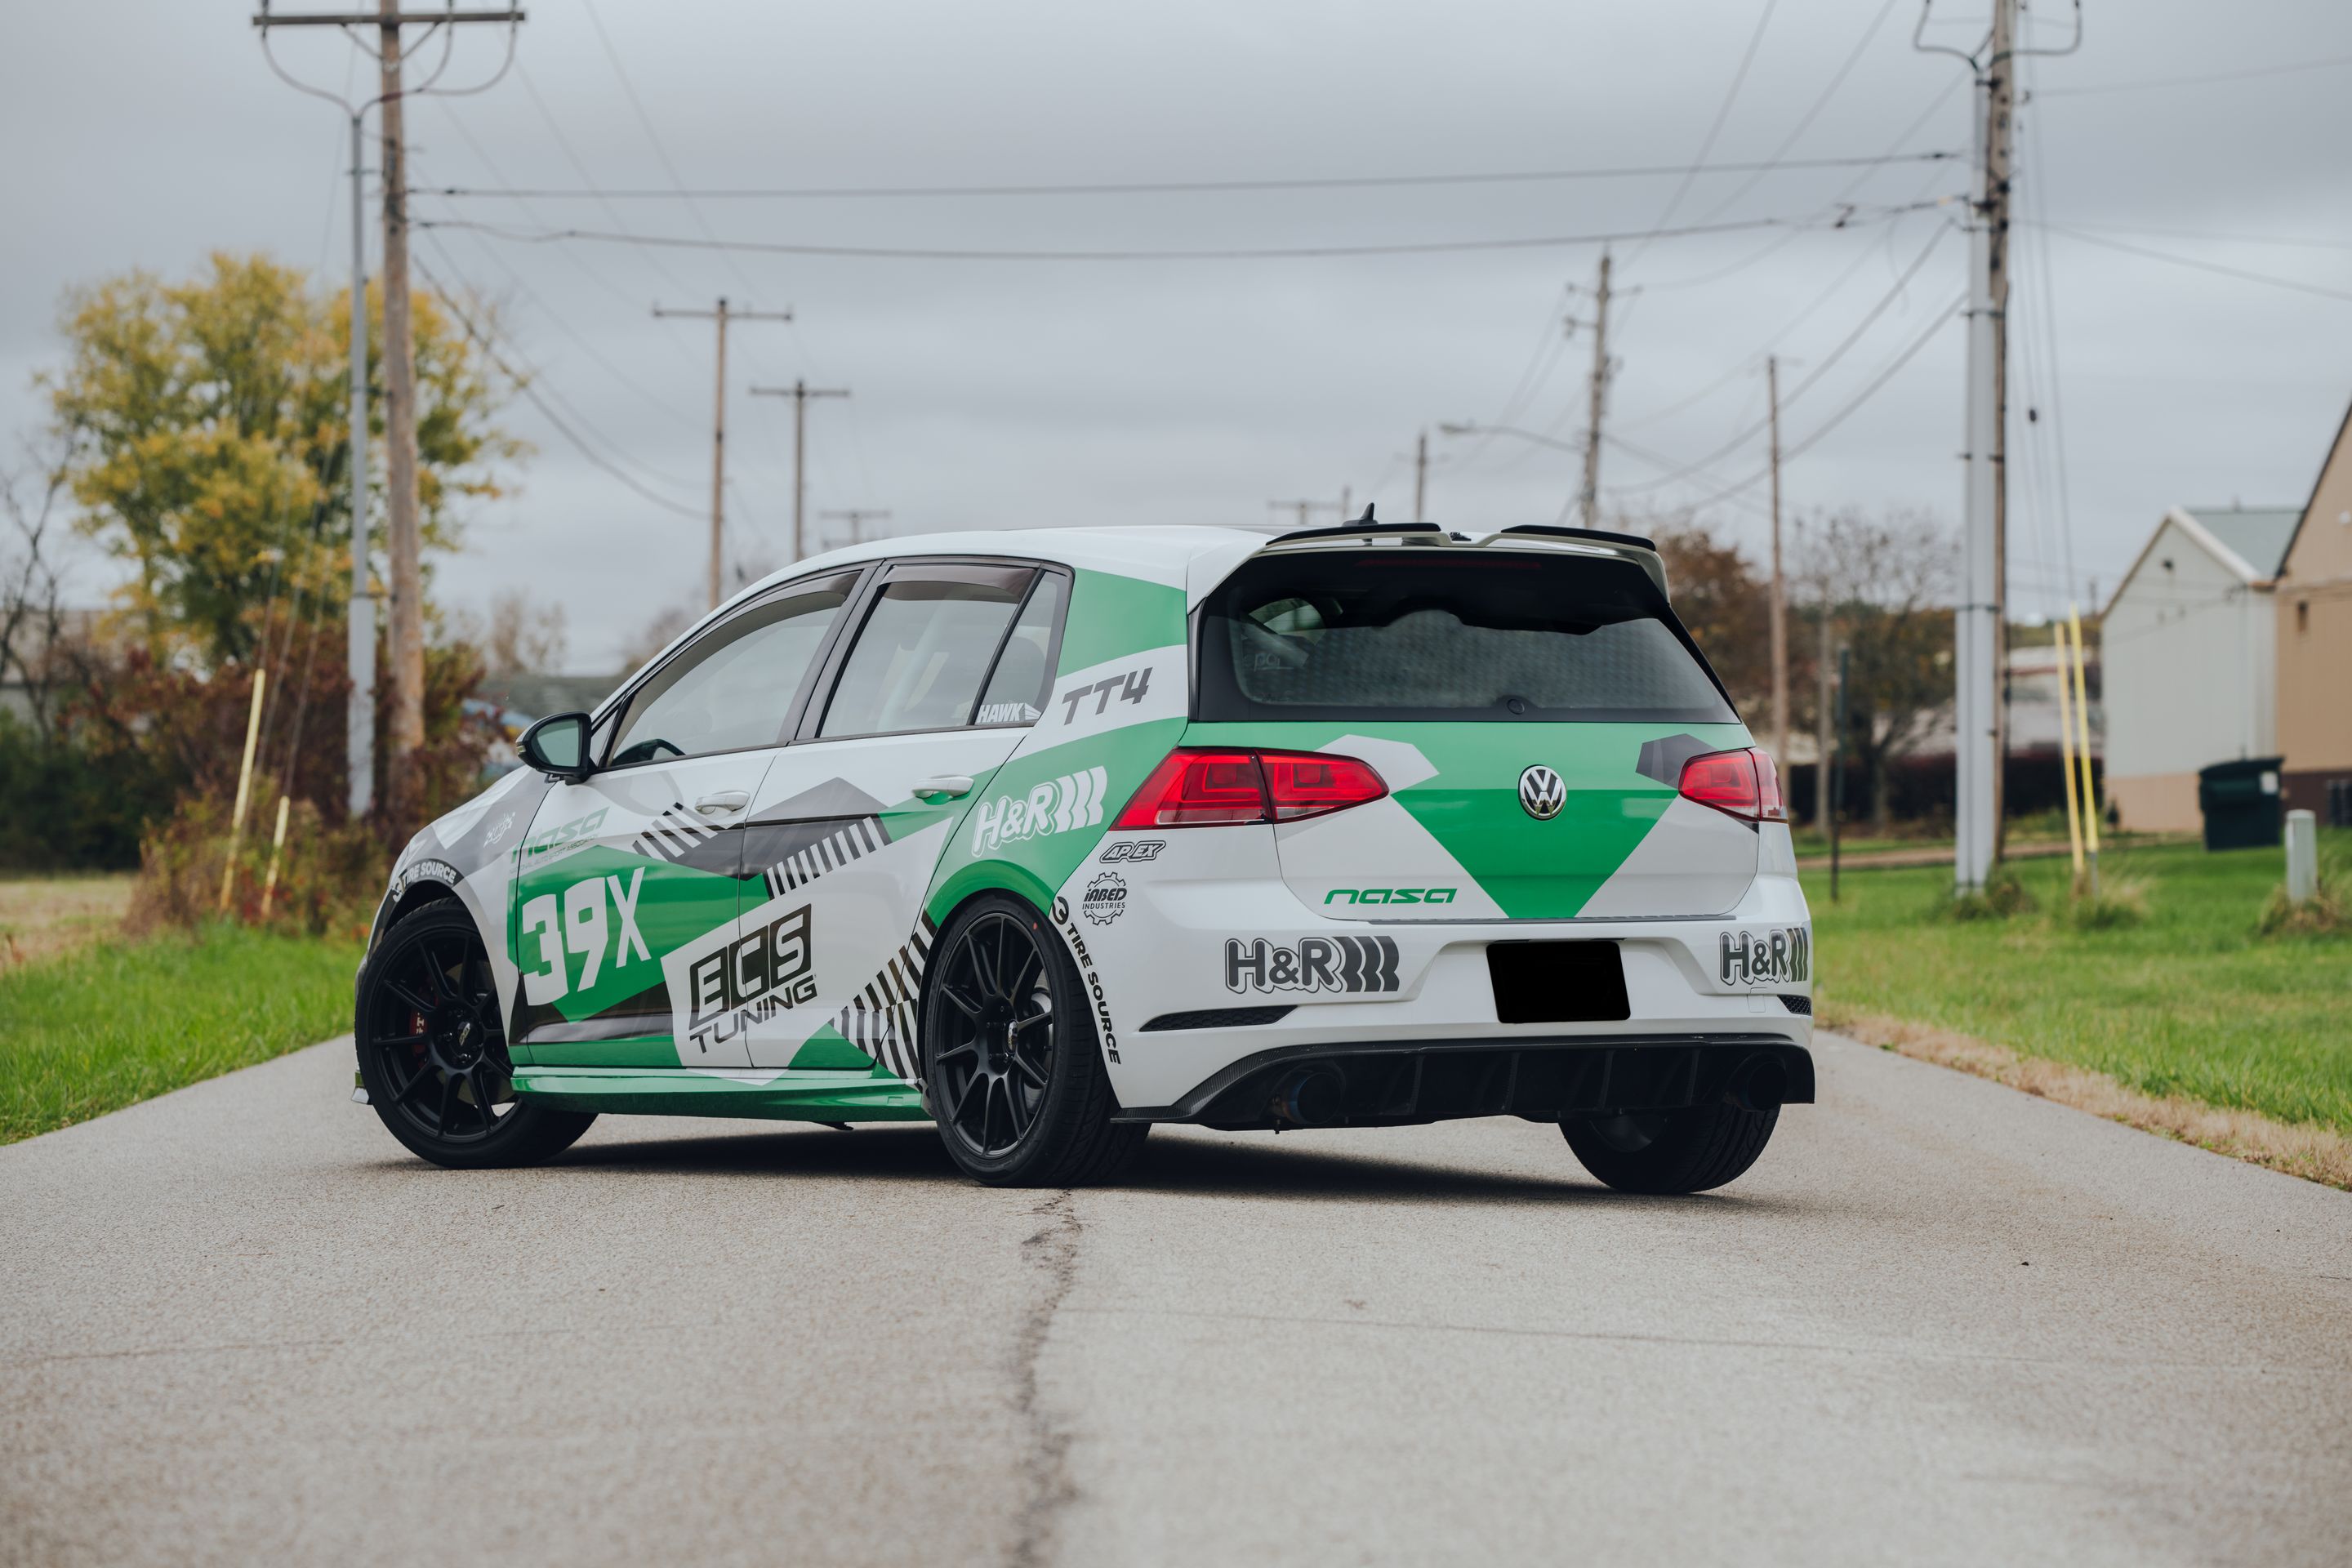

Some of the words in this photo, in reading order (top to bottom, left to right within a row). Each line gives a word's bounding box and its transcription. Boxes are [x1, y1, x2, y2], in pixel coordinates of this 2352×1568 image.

[976, 702, 1025, 723] HAWK
[1062, 666, 1153, 725] TT4
[972, 782, 1059, 857] H&R
[421, 862, 457, 884] SOURCE
[1101, 842, 1165, 862] APEX
[1082, 902, 1125, 910] INDUSTRIES
[1324, 888, 1458, 905] nasa
[522, 866, 652, 1006] 39X
[1720, 929, 1790, 986] H&R
[688, 903, 813, 1031] ECS
[1067, 923, 1094, 969] TIRE
[1088, 971, 1121, 1065] SOURCE
[1225, 937, 1343, 994] H&R
[689, 975, 817, 1054] TUNING
